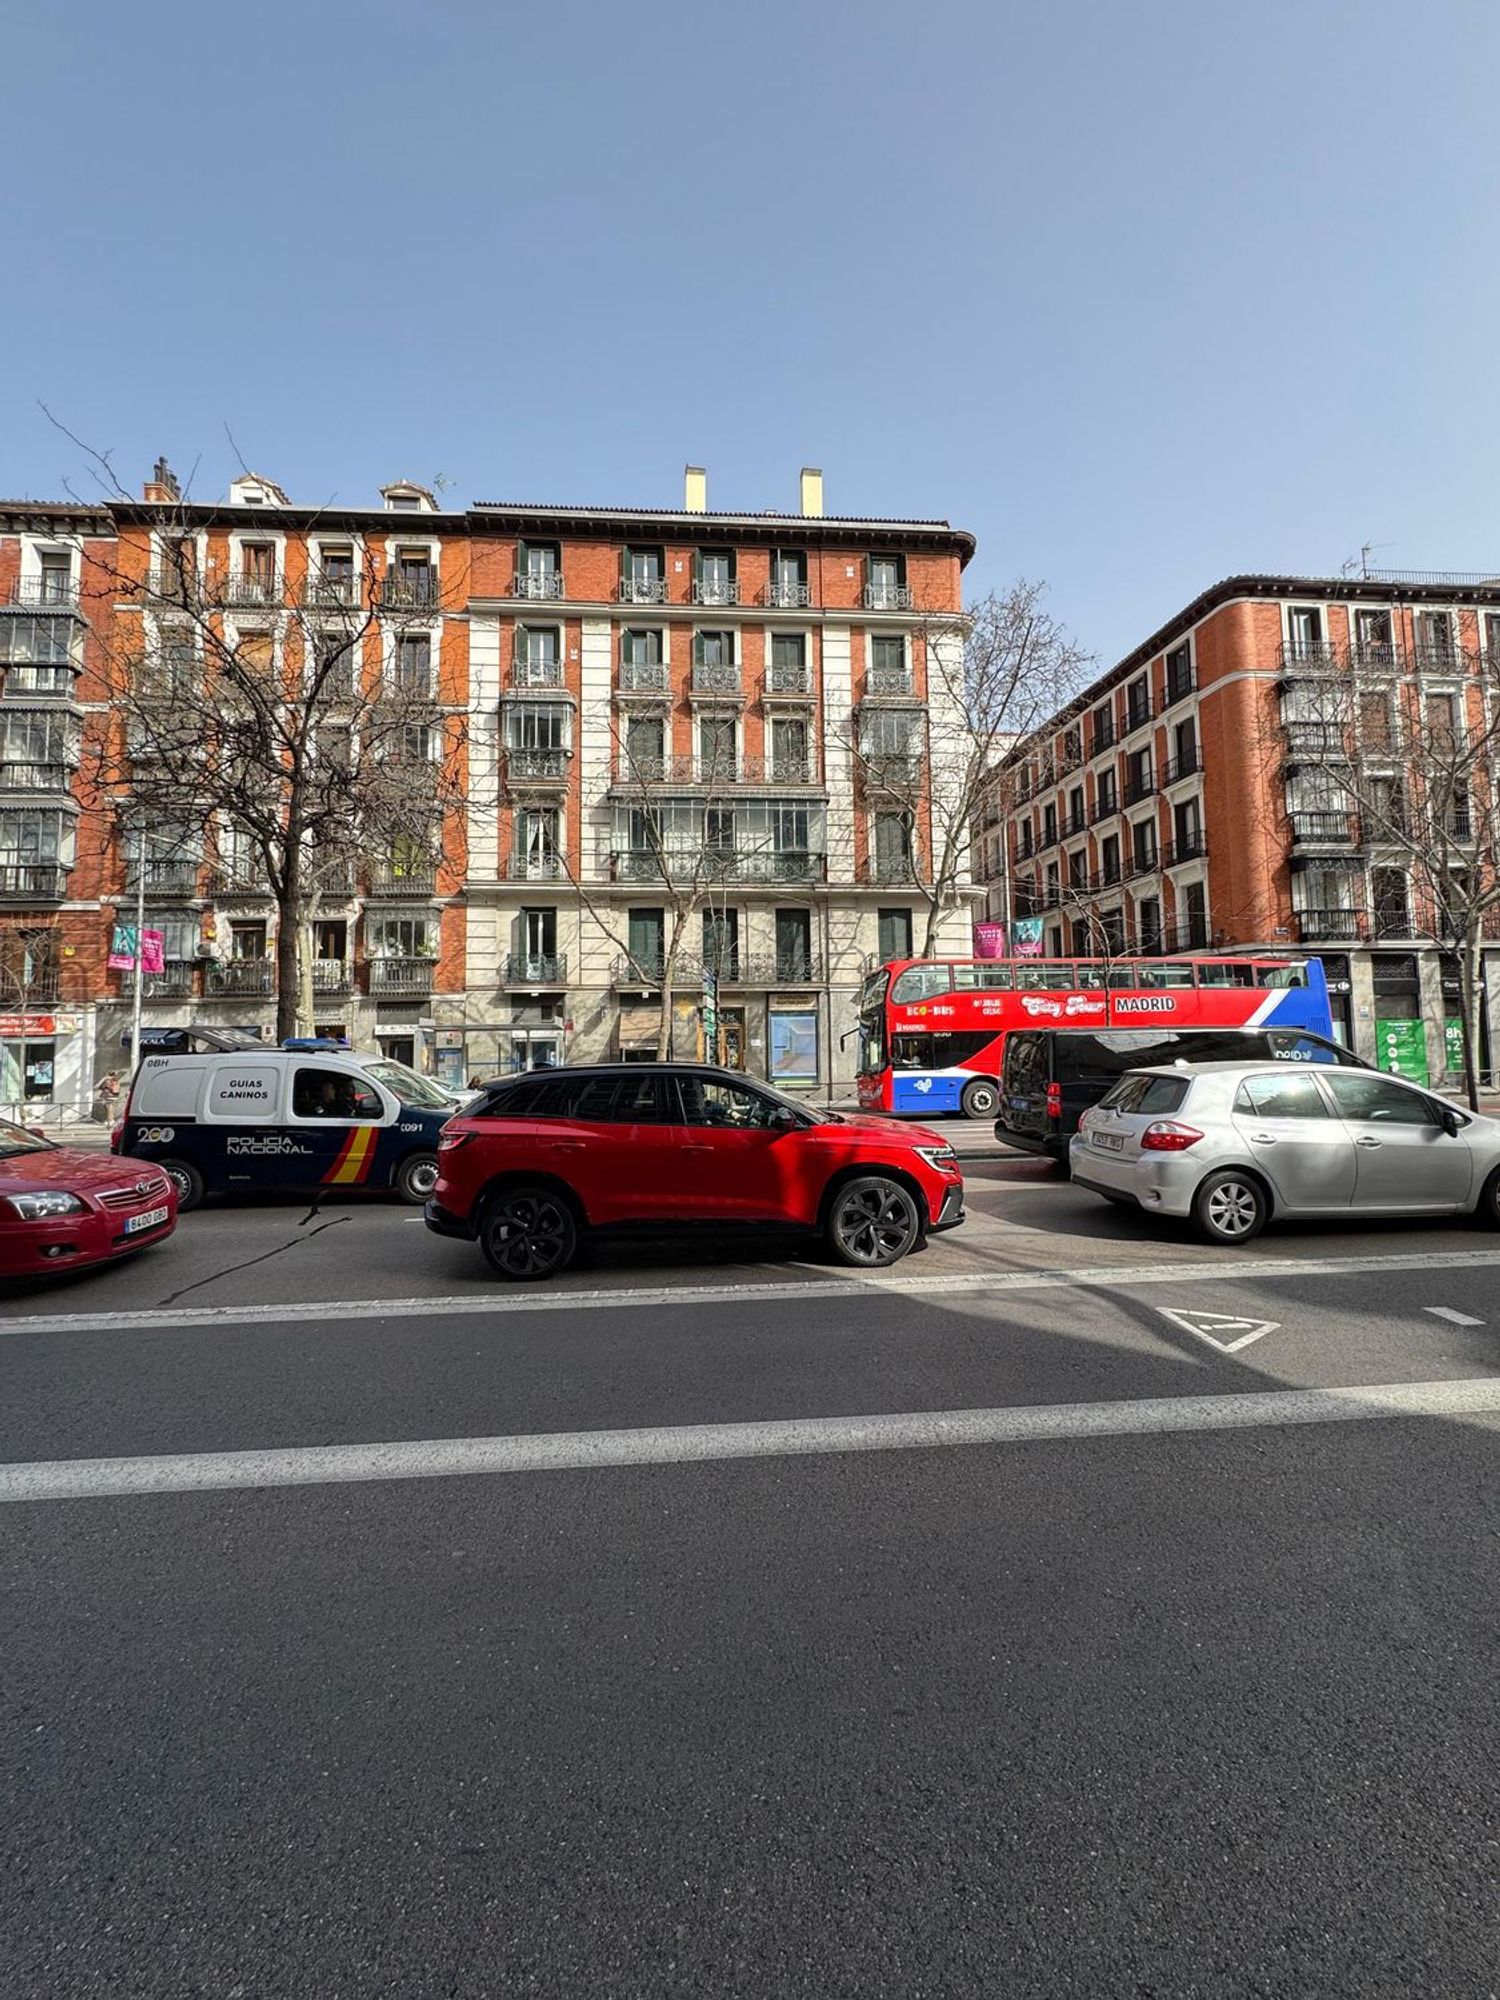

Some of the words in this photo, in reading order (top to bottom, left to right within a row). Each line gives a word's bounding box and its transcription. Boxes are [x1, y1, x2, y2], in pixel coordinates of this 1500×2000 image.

[1116, 998, 1175, 1011] MADRID
[229, 1080, 263, 1088] GUIAS
[220, 1091, 268, 1099] CANINOS
[227, 1145, 314, 1155] NACIONAL
